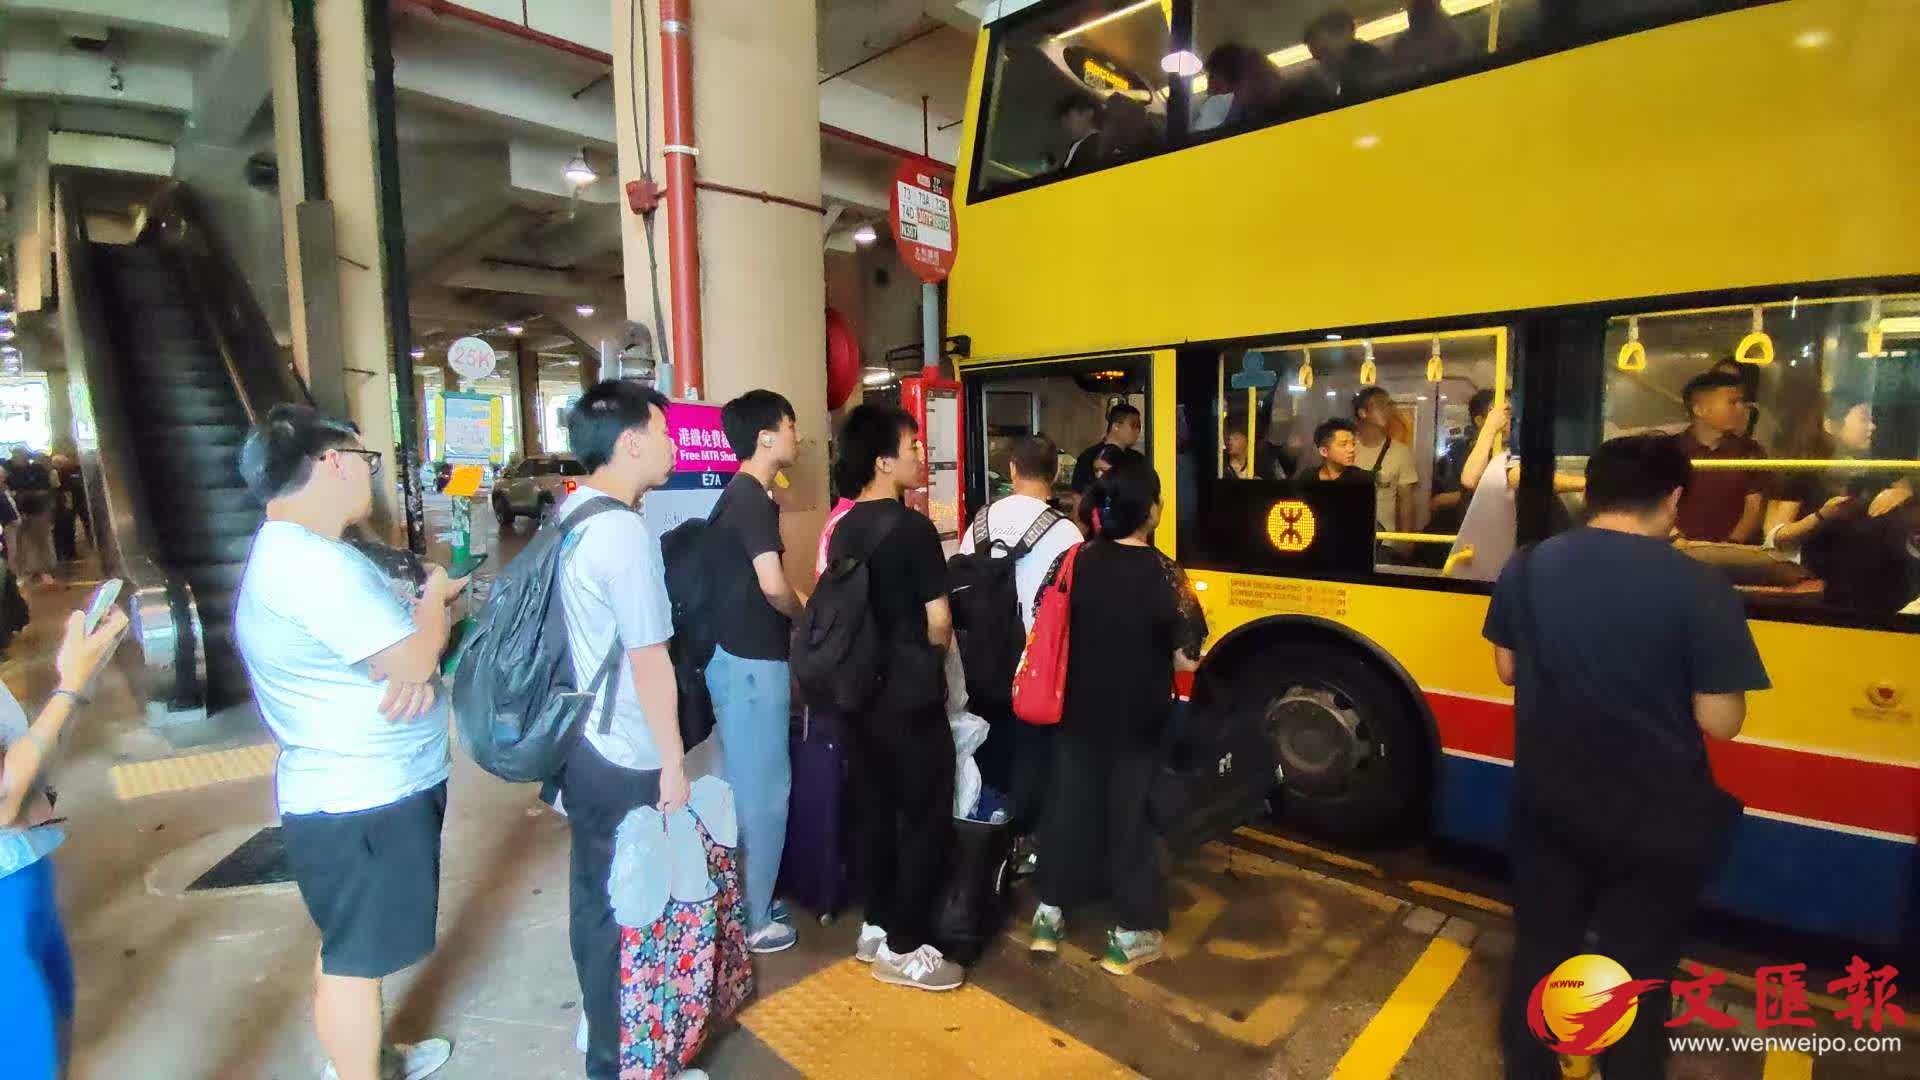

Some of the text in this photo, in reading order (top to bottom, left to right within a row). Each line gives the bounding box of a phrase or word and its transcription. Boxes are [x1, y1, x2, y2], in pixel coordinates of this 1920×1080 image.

[903, 186, 948, 213] 73 73A 73B
[902, 204, 915, 219] 74D
[455, 348, 490, 367] 25K
[680, 450, 700, 460] Free
[701, 450, 719, 461] MTR
[703, 473, 722, 486] E7A
